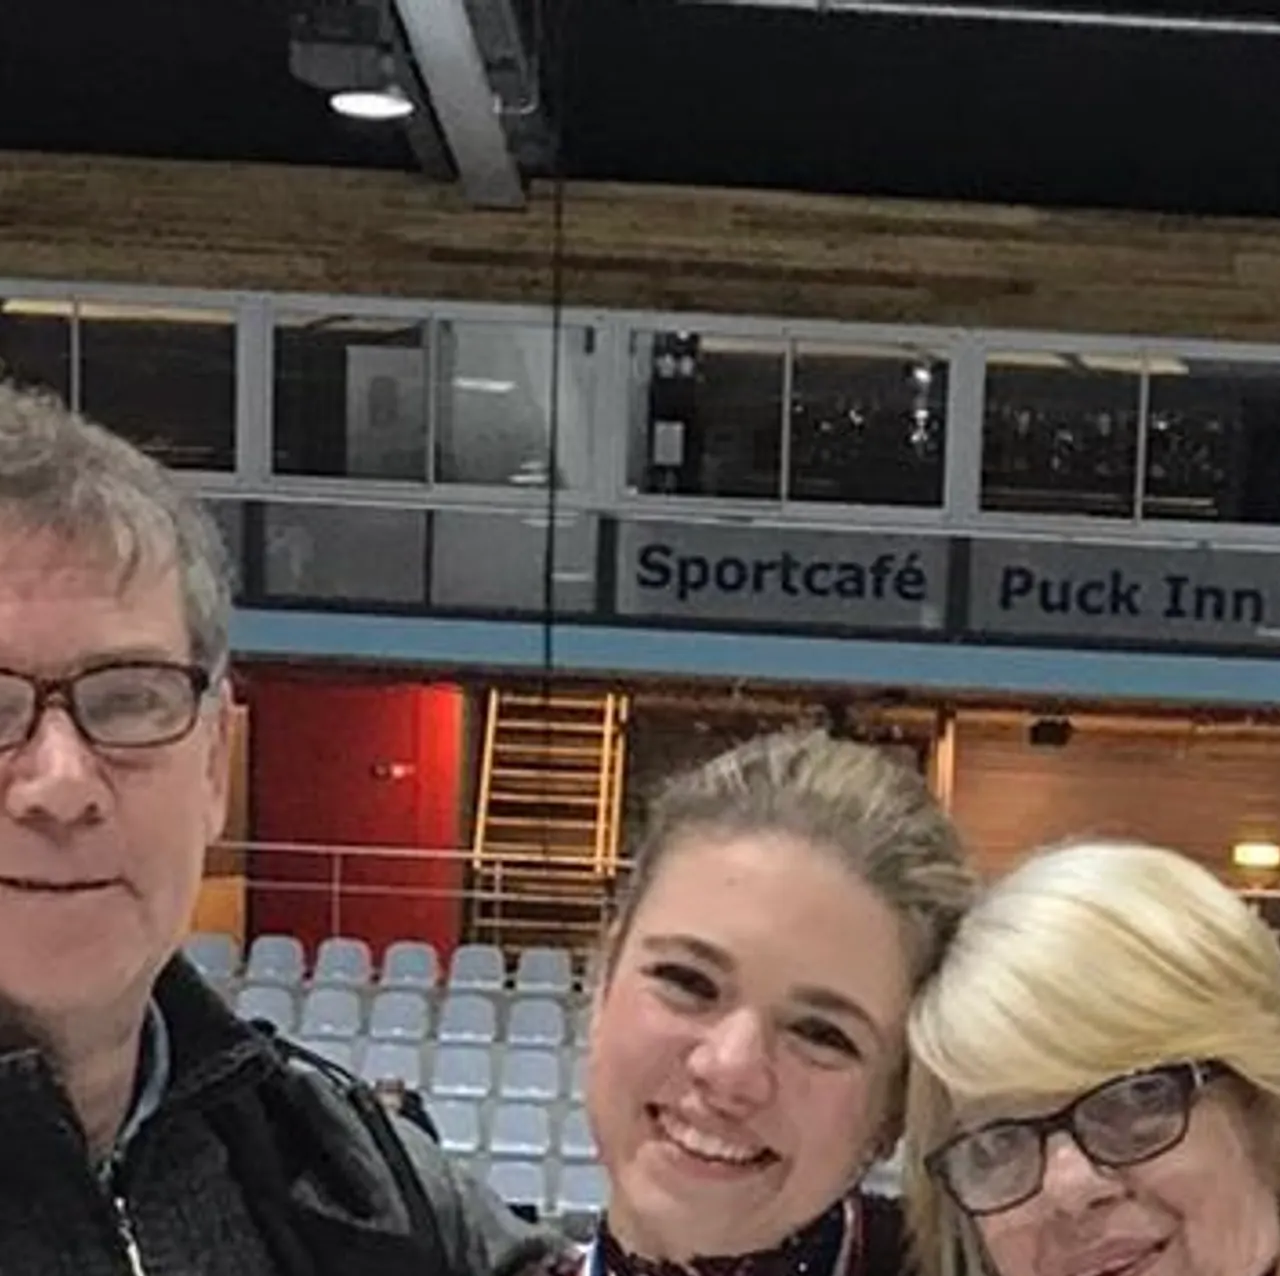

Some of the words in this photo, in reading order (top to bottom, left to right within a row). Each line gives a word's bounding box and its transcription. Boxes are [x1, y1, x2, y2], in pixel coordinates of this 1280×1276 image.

[636, 544, 927, 602] Sportcafé
[999, 564, 1141, 616] Puck
[1162, 575, 1265, 623] Inn
